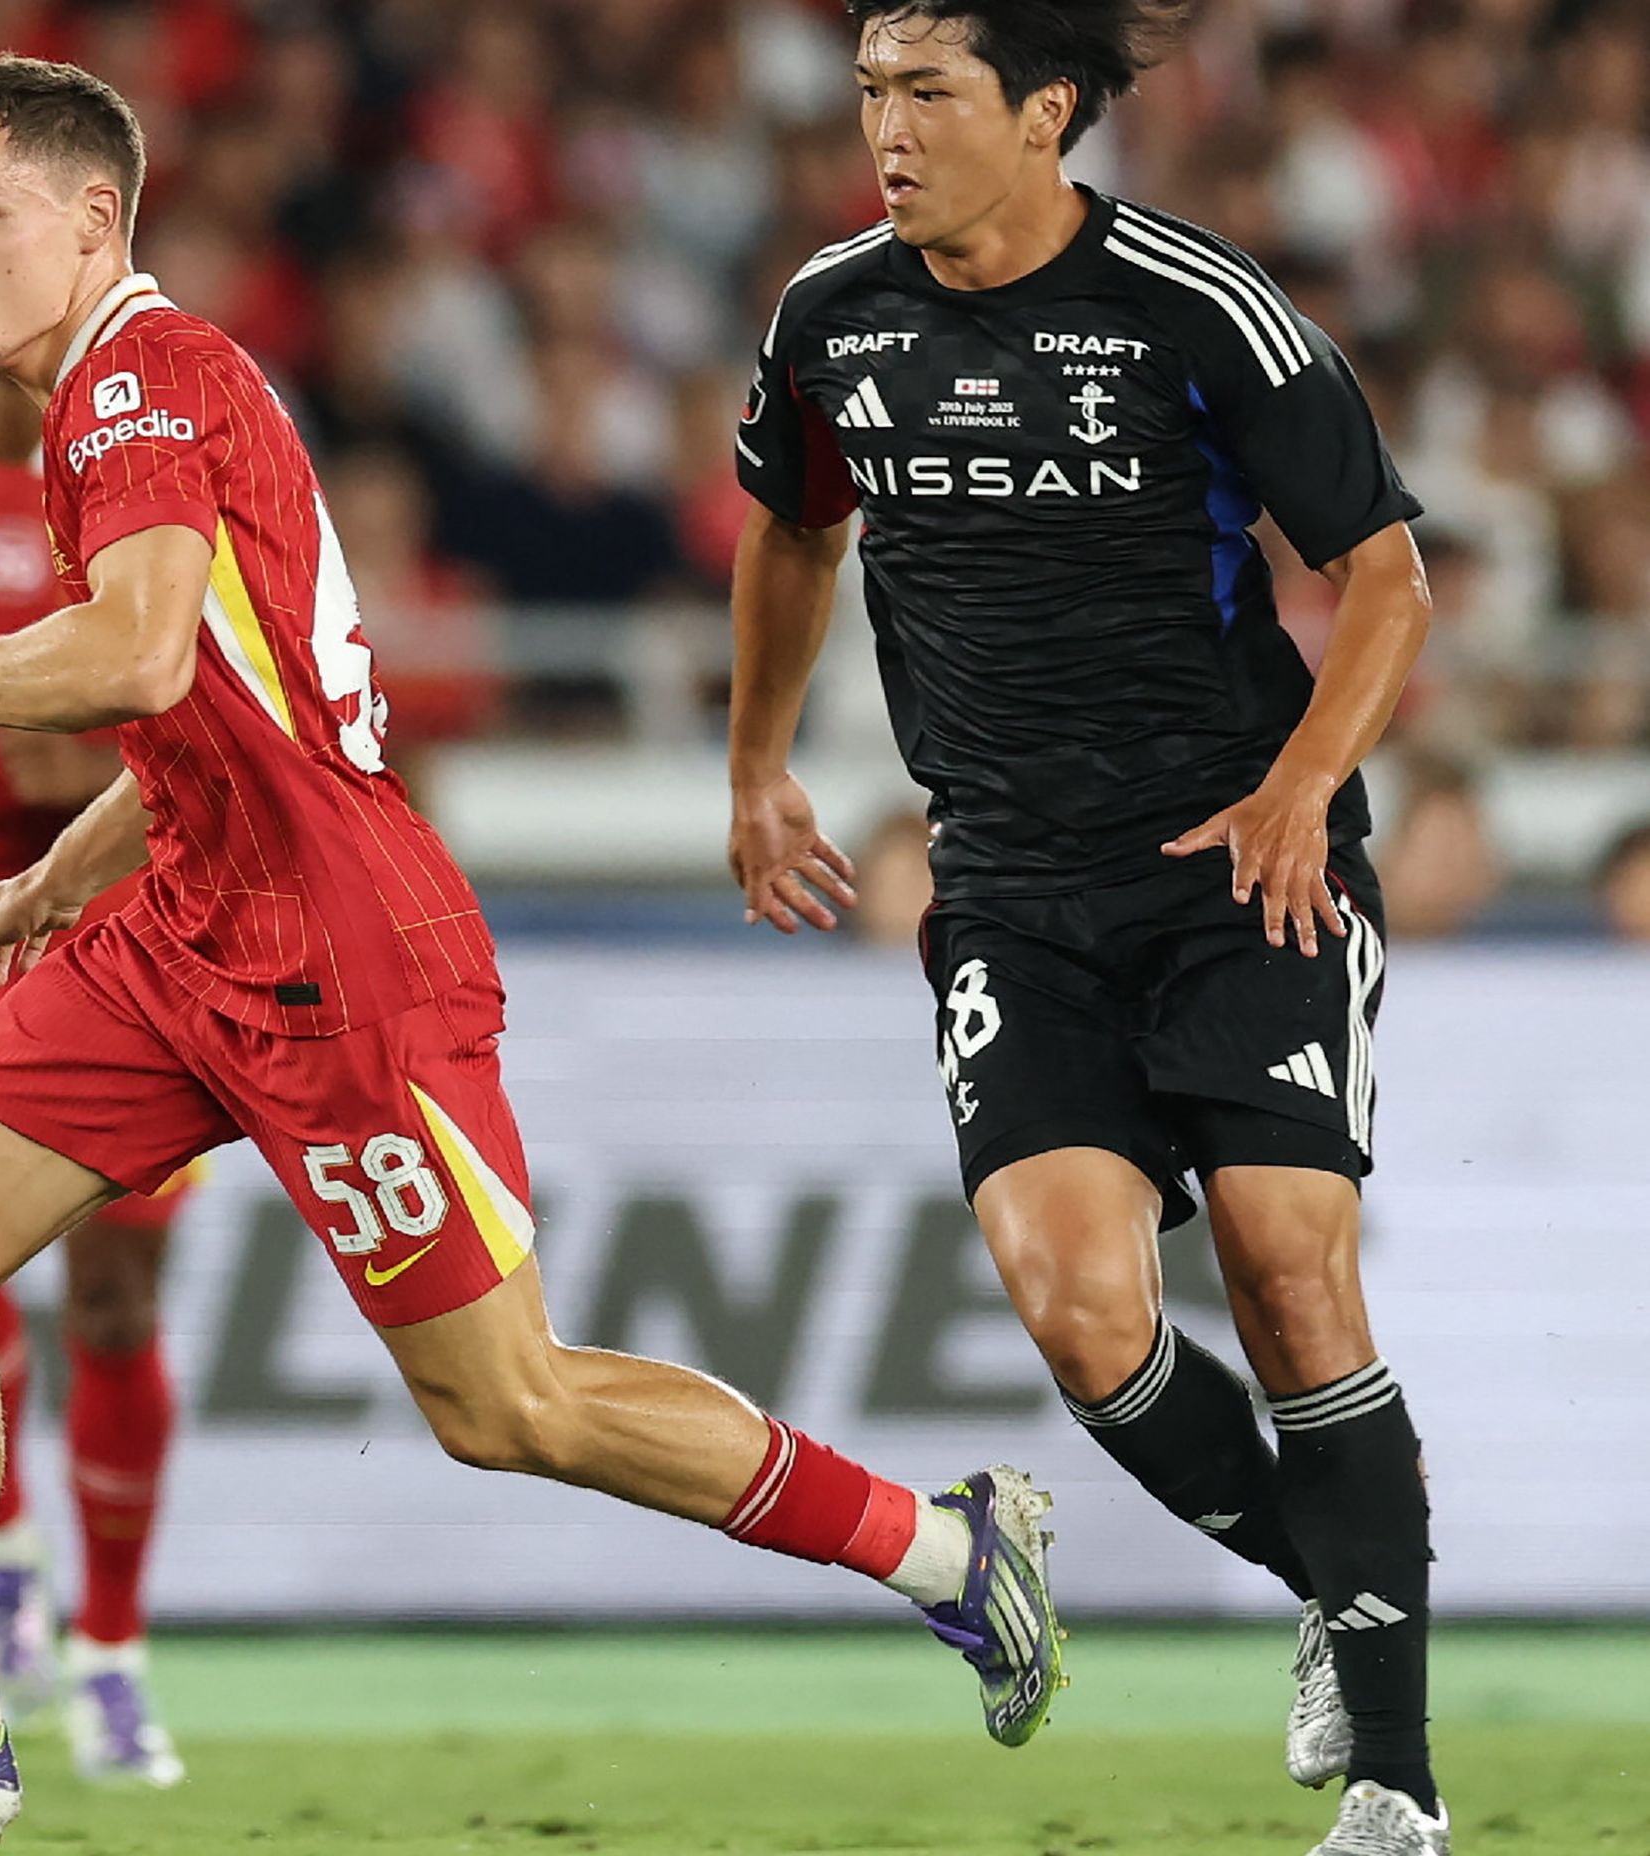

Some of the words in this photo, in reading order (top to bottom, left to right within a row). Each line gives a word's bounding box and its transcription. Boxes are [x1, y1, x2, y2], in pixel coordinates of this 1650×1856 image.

[826, 332, 919, 359] DRAFT
[1034, 332, 1150, 360] DRAFT
[928, 417, 941, 426] vs
[943, 415, 1006, 427] LIVERPOOL
[1007, 416, 1021, 427] FC
[937, 401, 962, 413] 30th
[964, 401, 986, 415] July
[68, 409, 195, 474] Expedia
[845, 457, 1141, 497] NISSAN
[302, 1133, 450, 1257] 58
[995, 1666, 1042, 1738] F50
